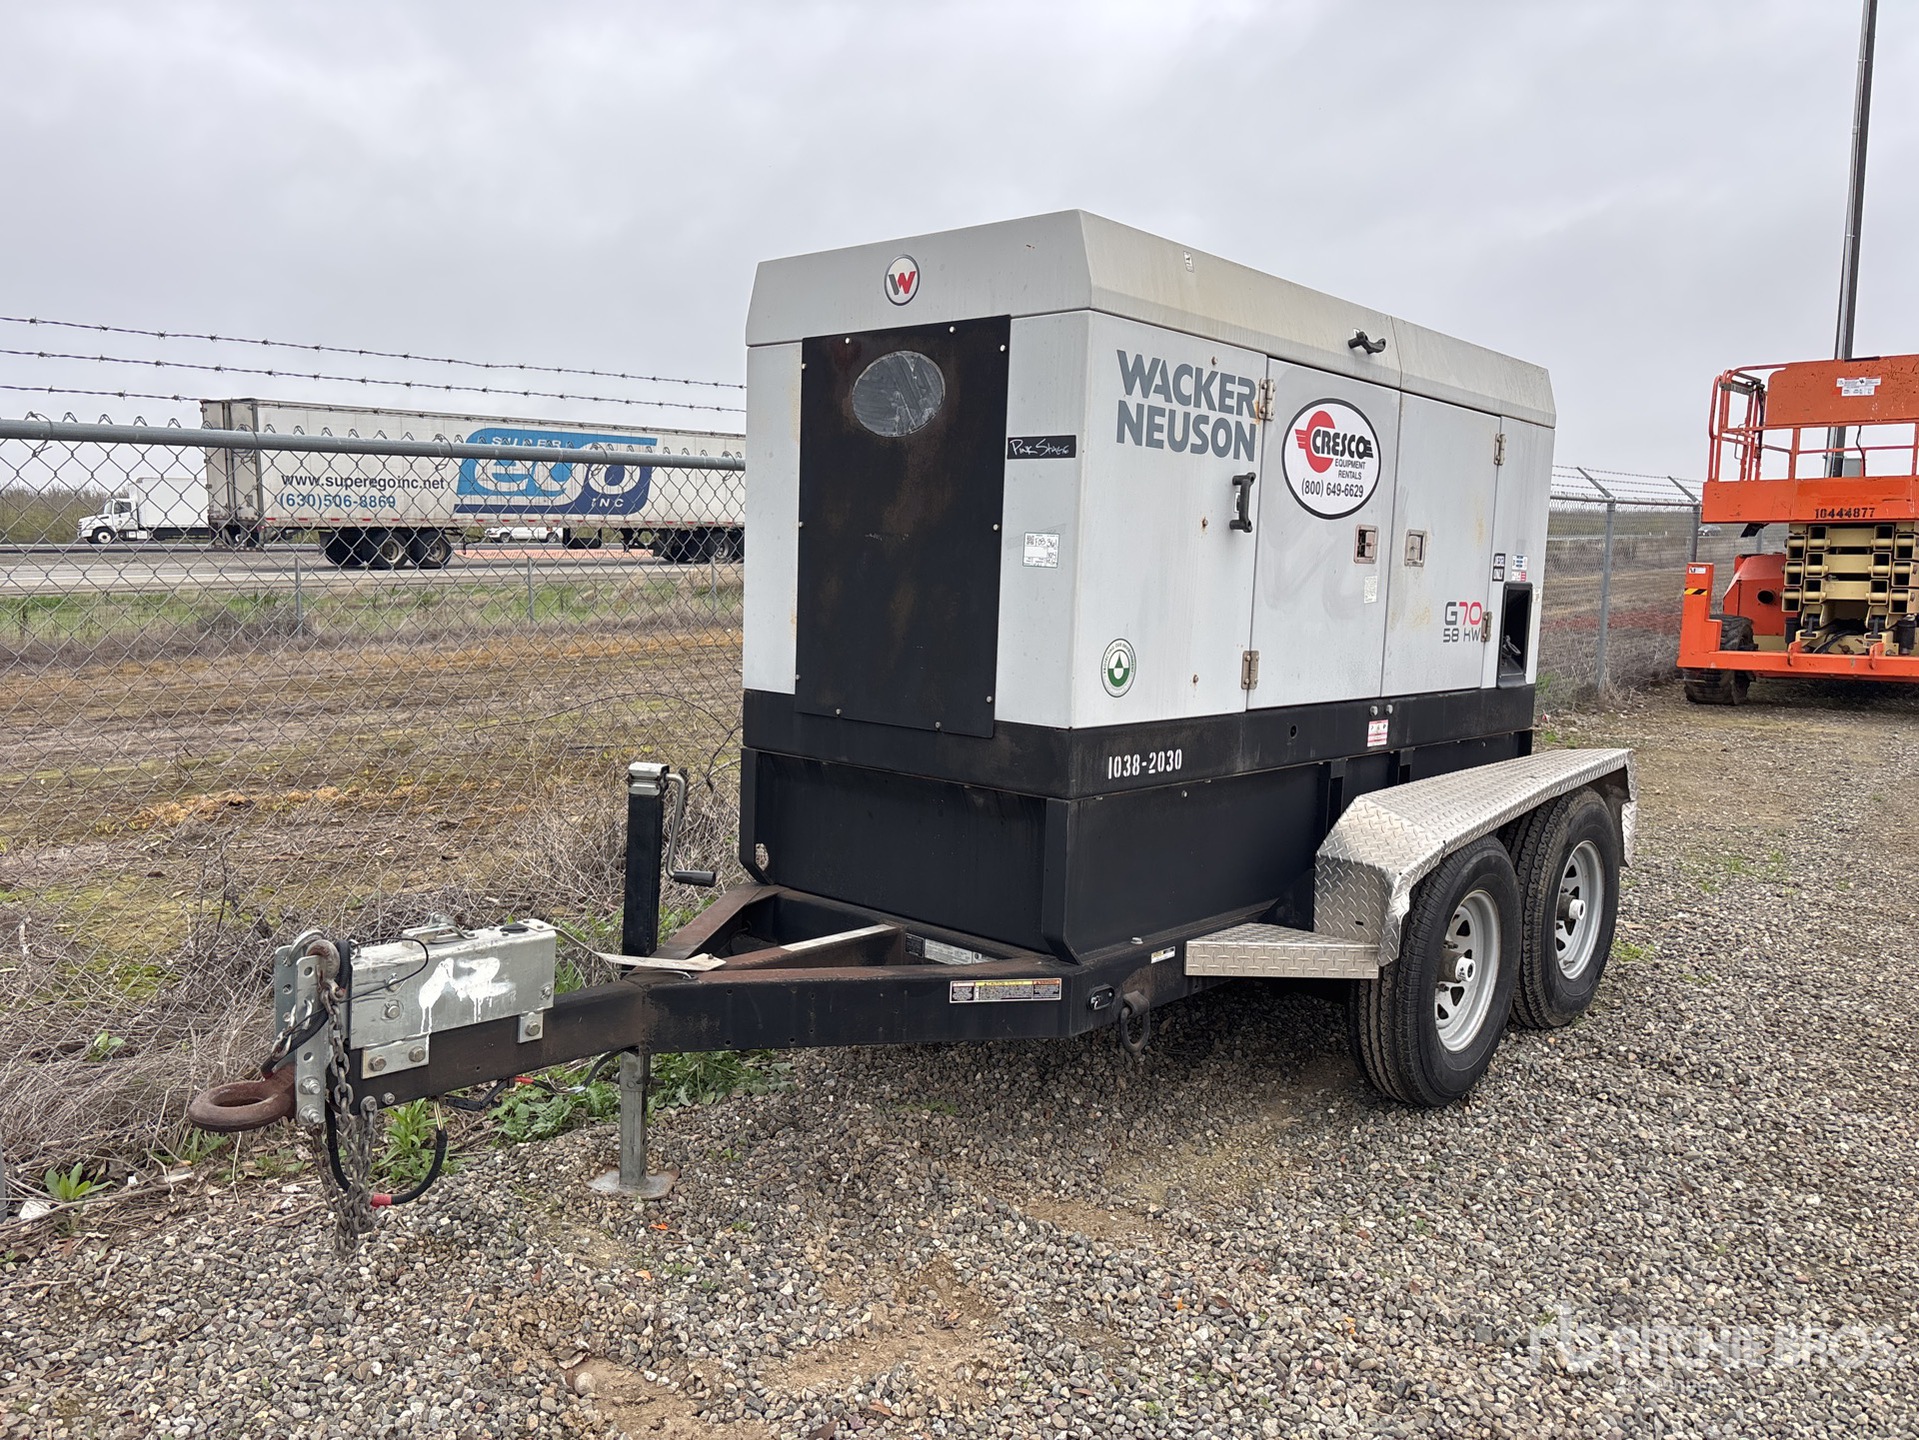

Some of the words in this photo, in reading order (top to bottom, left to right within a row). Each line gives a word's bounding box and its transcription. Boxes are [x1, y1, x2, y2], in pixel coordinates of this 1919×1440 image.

[887, 270, 917, 296] W
[1116, 349, 1257, 419] WACKER
[1116, 399, 1257, 462] NEUSON
[1312, 428, 1372, 460] CRESCO
[1334, 458, 1367, 470] EQUIPMENT
[1337, 469, 1363, 481] RENTALS
[281, 475, 445, 492] www.superegoinc.net
[1301, 478, 1324, 498] (800)
[1326, 482, 1365, 498] 649-6629
[1814, 507, 1876, 519] 10444877
[1444, 601, 1483, 626] G70
[1443, 627, 1460, 643] 58
[1107, 748, 1183, 780] 1038-2030
